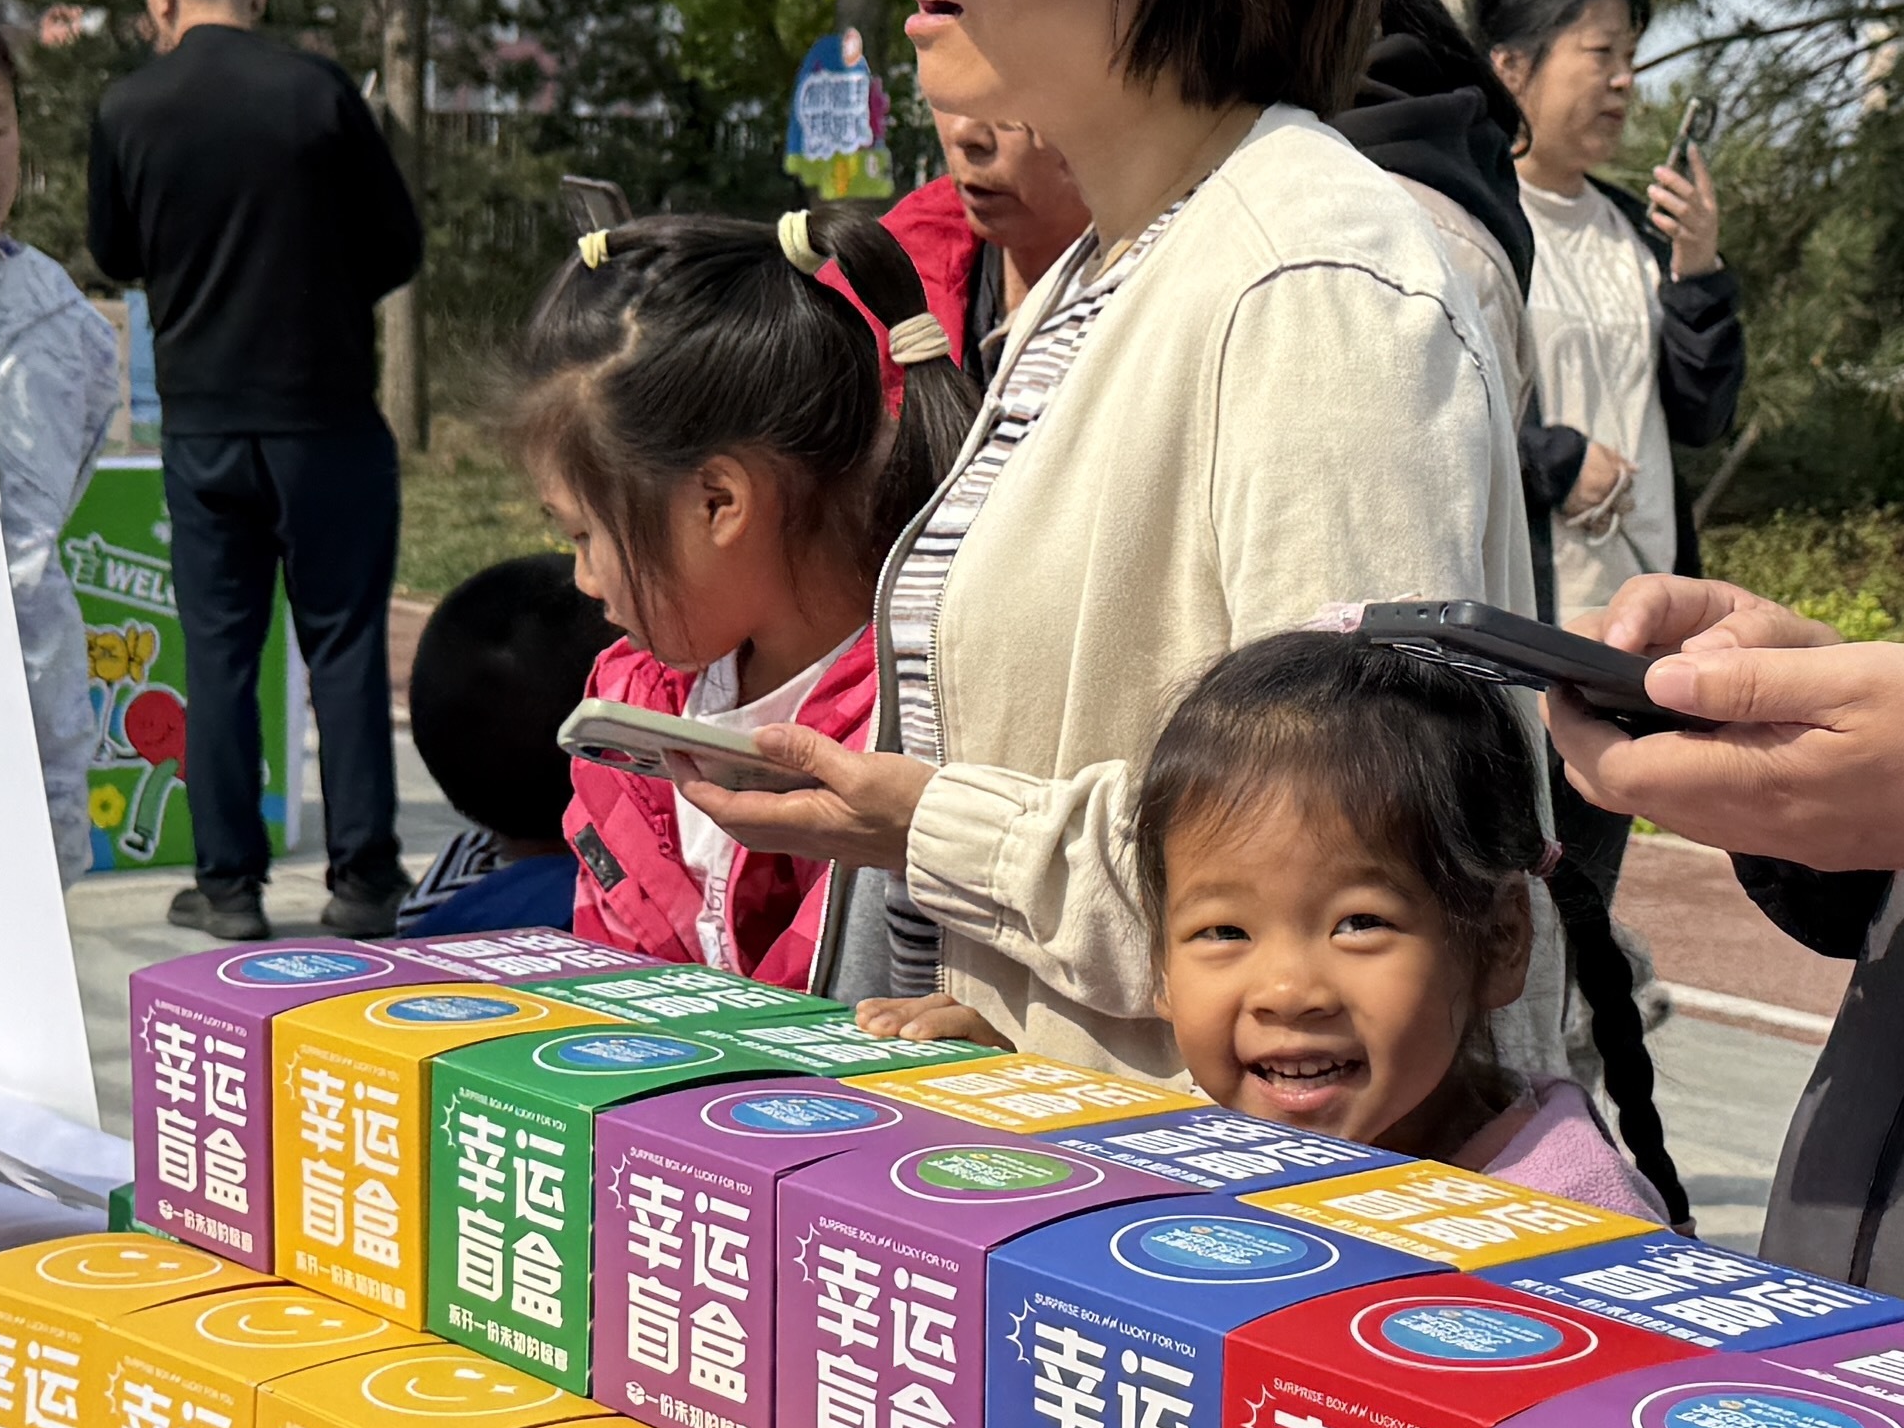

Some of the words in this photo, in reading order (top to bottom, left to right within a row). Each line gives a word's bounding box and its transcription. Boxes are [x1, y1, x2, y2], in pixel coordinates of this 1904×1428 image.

[154, 1022, 246, 1126] 幸运
[300, 1068, 399, 1175] 幸运
[156, 1106, 248, 1213] 盲盒
[302, 1158, 399, 1267] 盲盒
[458, 1112, 564, 1230] 幸运
[457, 1206, 562, 1327] 盲盒
[628, 1173, 749, 1300] 幸运
[1639, 1249, 1873, 1318] 幸运
[628, 1273, 747, 1403] 盲盒
[817, 1244, 956, 1383] 幸运
[1034, 1291, 1080, 1319] SURPRISE
[1080, 1307, 1101, 1325] BOX
[1118, 1320, 1150, 1342] LUCKY
[1151, 1332, 1173, 1350] FOR
[1173, 1339, 1196, 1359] YOU
[1559, 1264, 1780, 1337] 盲盒
[1273, 1375, 1325, 1406] SURPRISE
[1325, 1394, 1348, 1414] BOX
